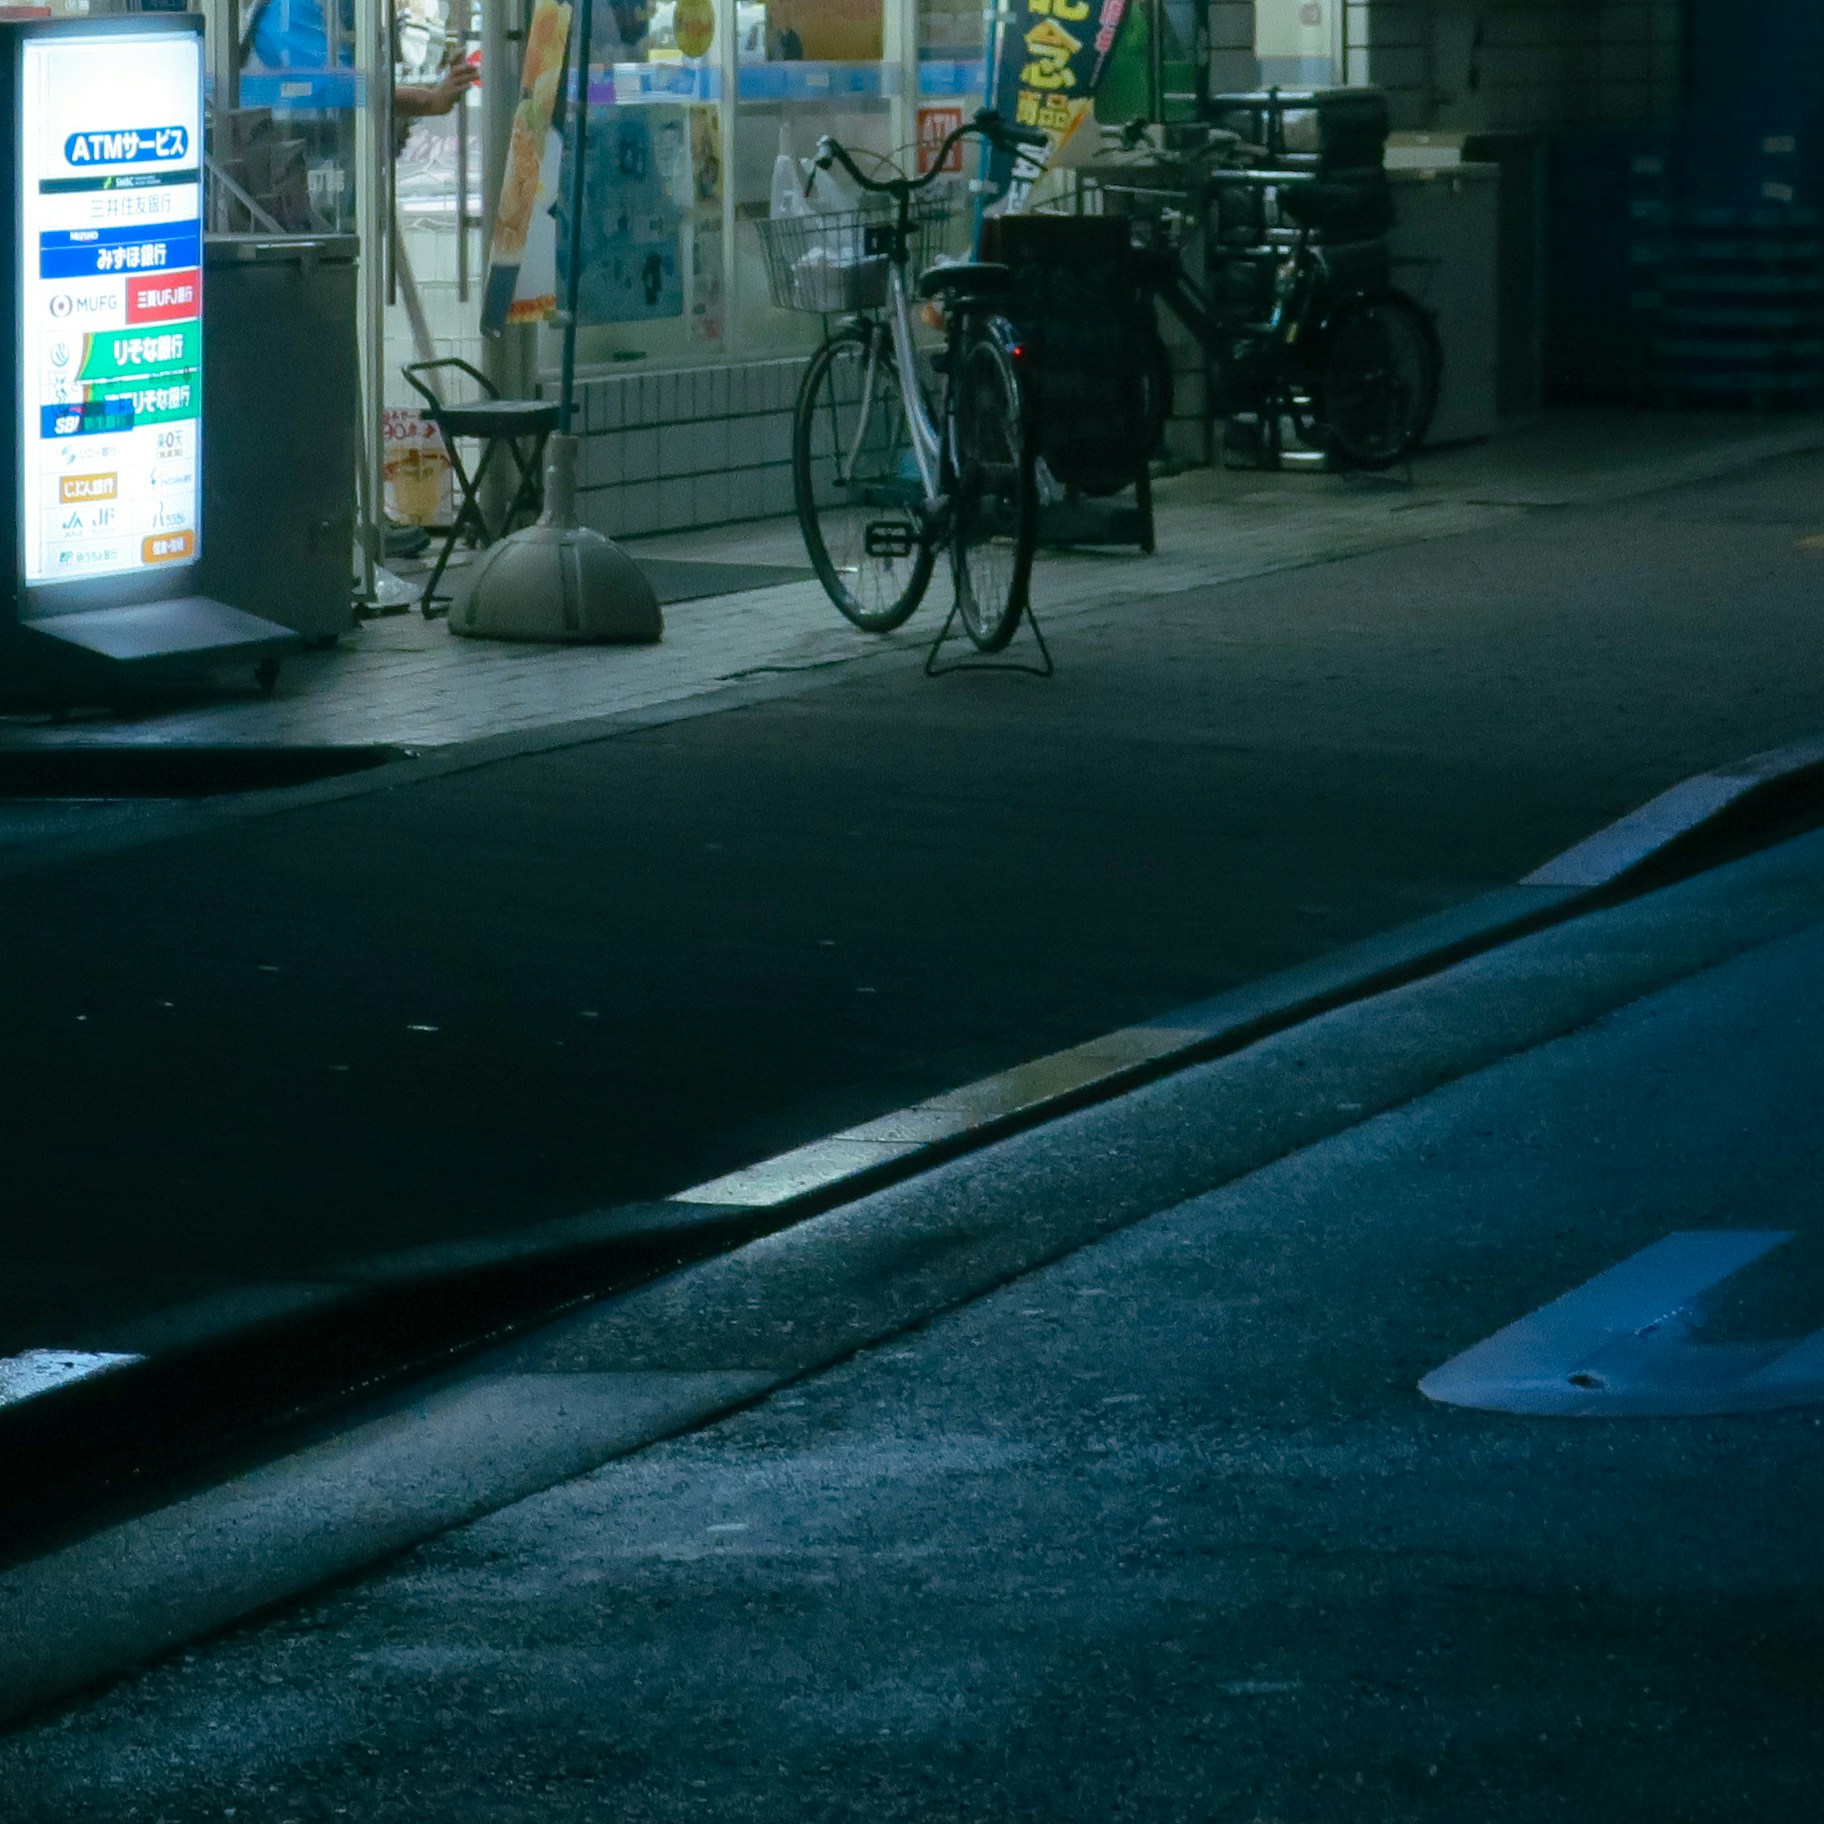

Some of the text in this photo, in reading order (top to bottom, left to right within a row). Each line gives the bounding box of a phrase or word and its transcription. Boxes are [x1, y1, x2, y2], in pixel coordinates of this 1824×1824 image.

[71, 129, 184, 162] ATMサービス
[91, 193, 171, 218] 三井住友銀行
[96, 243, 167, 270] みずほ銀行
[76, 295, 117, 313] MUFG
[113, 333, 184, 366] りそな銀行
[105, 385, 190, 414] りそな銀行
